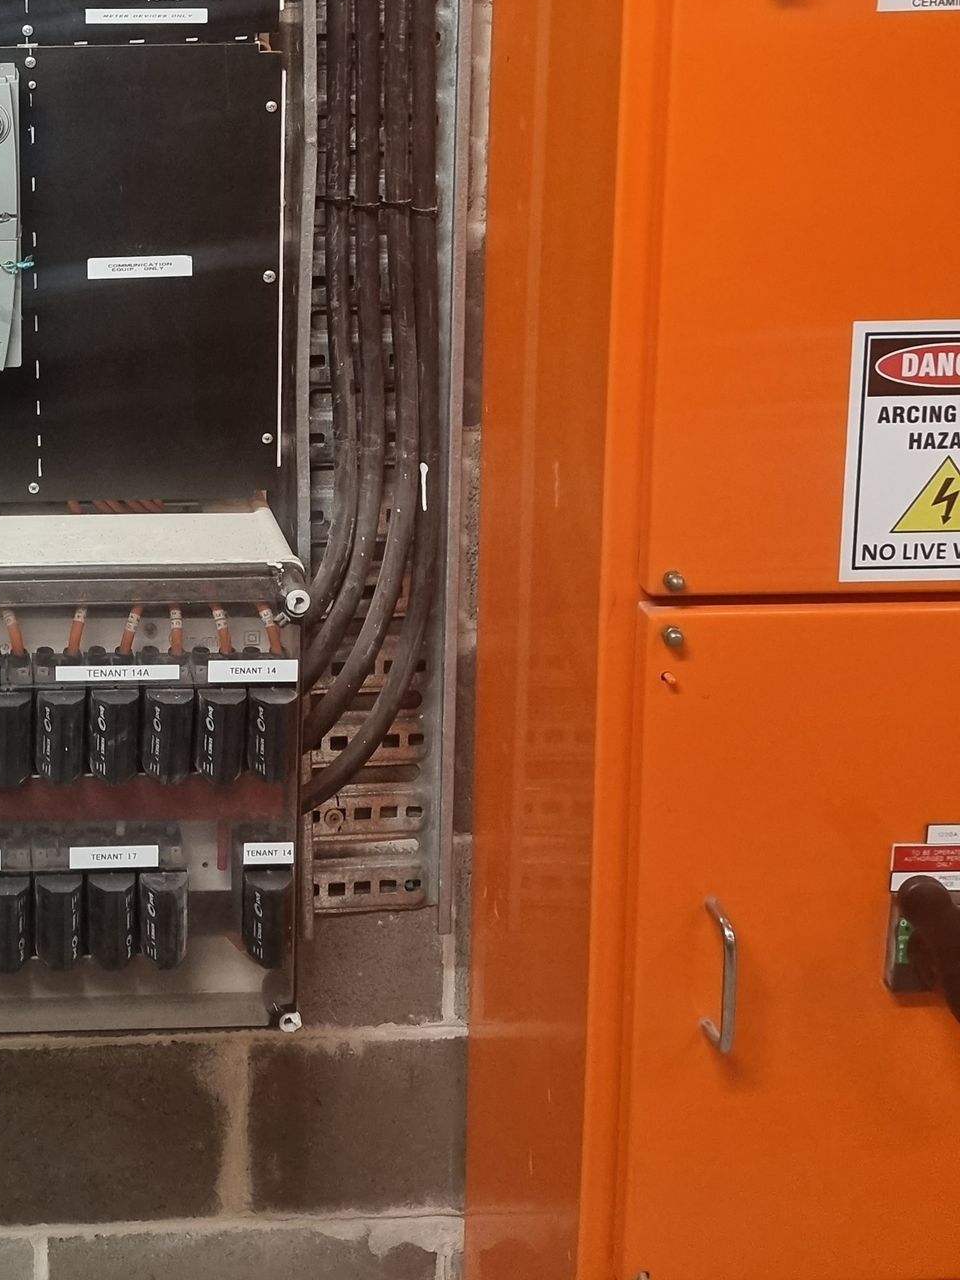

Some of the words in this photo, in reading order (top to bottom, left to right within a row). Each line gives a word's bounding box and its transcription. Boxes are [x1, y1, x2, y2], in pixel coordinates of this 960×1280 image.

[877, 405, 957, 424] ARCING
[861, 543, 896, 561] NO
[902, 542, 947, 560] LIVE
[87, 669, 128, 678] TENANT
[131, 669, 150, 677] 14A
[229, 667, 263, 675] TENANT
[91, 852, 123, 861] TENANT
[128, 852, 138, 860] 17
[246, 849, 279, 857] TENANT
